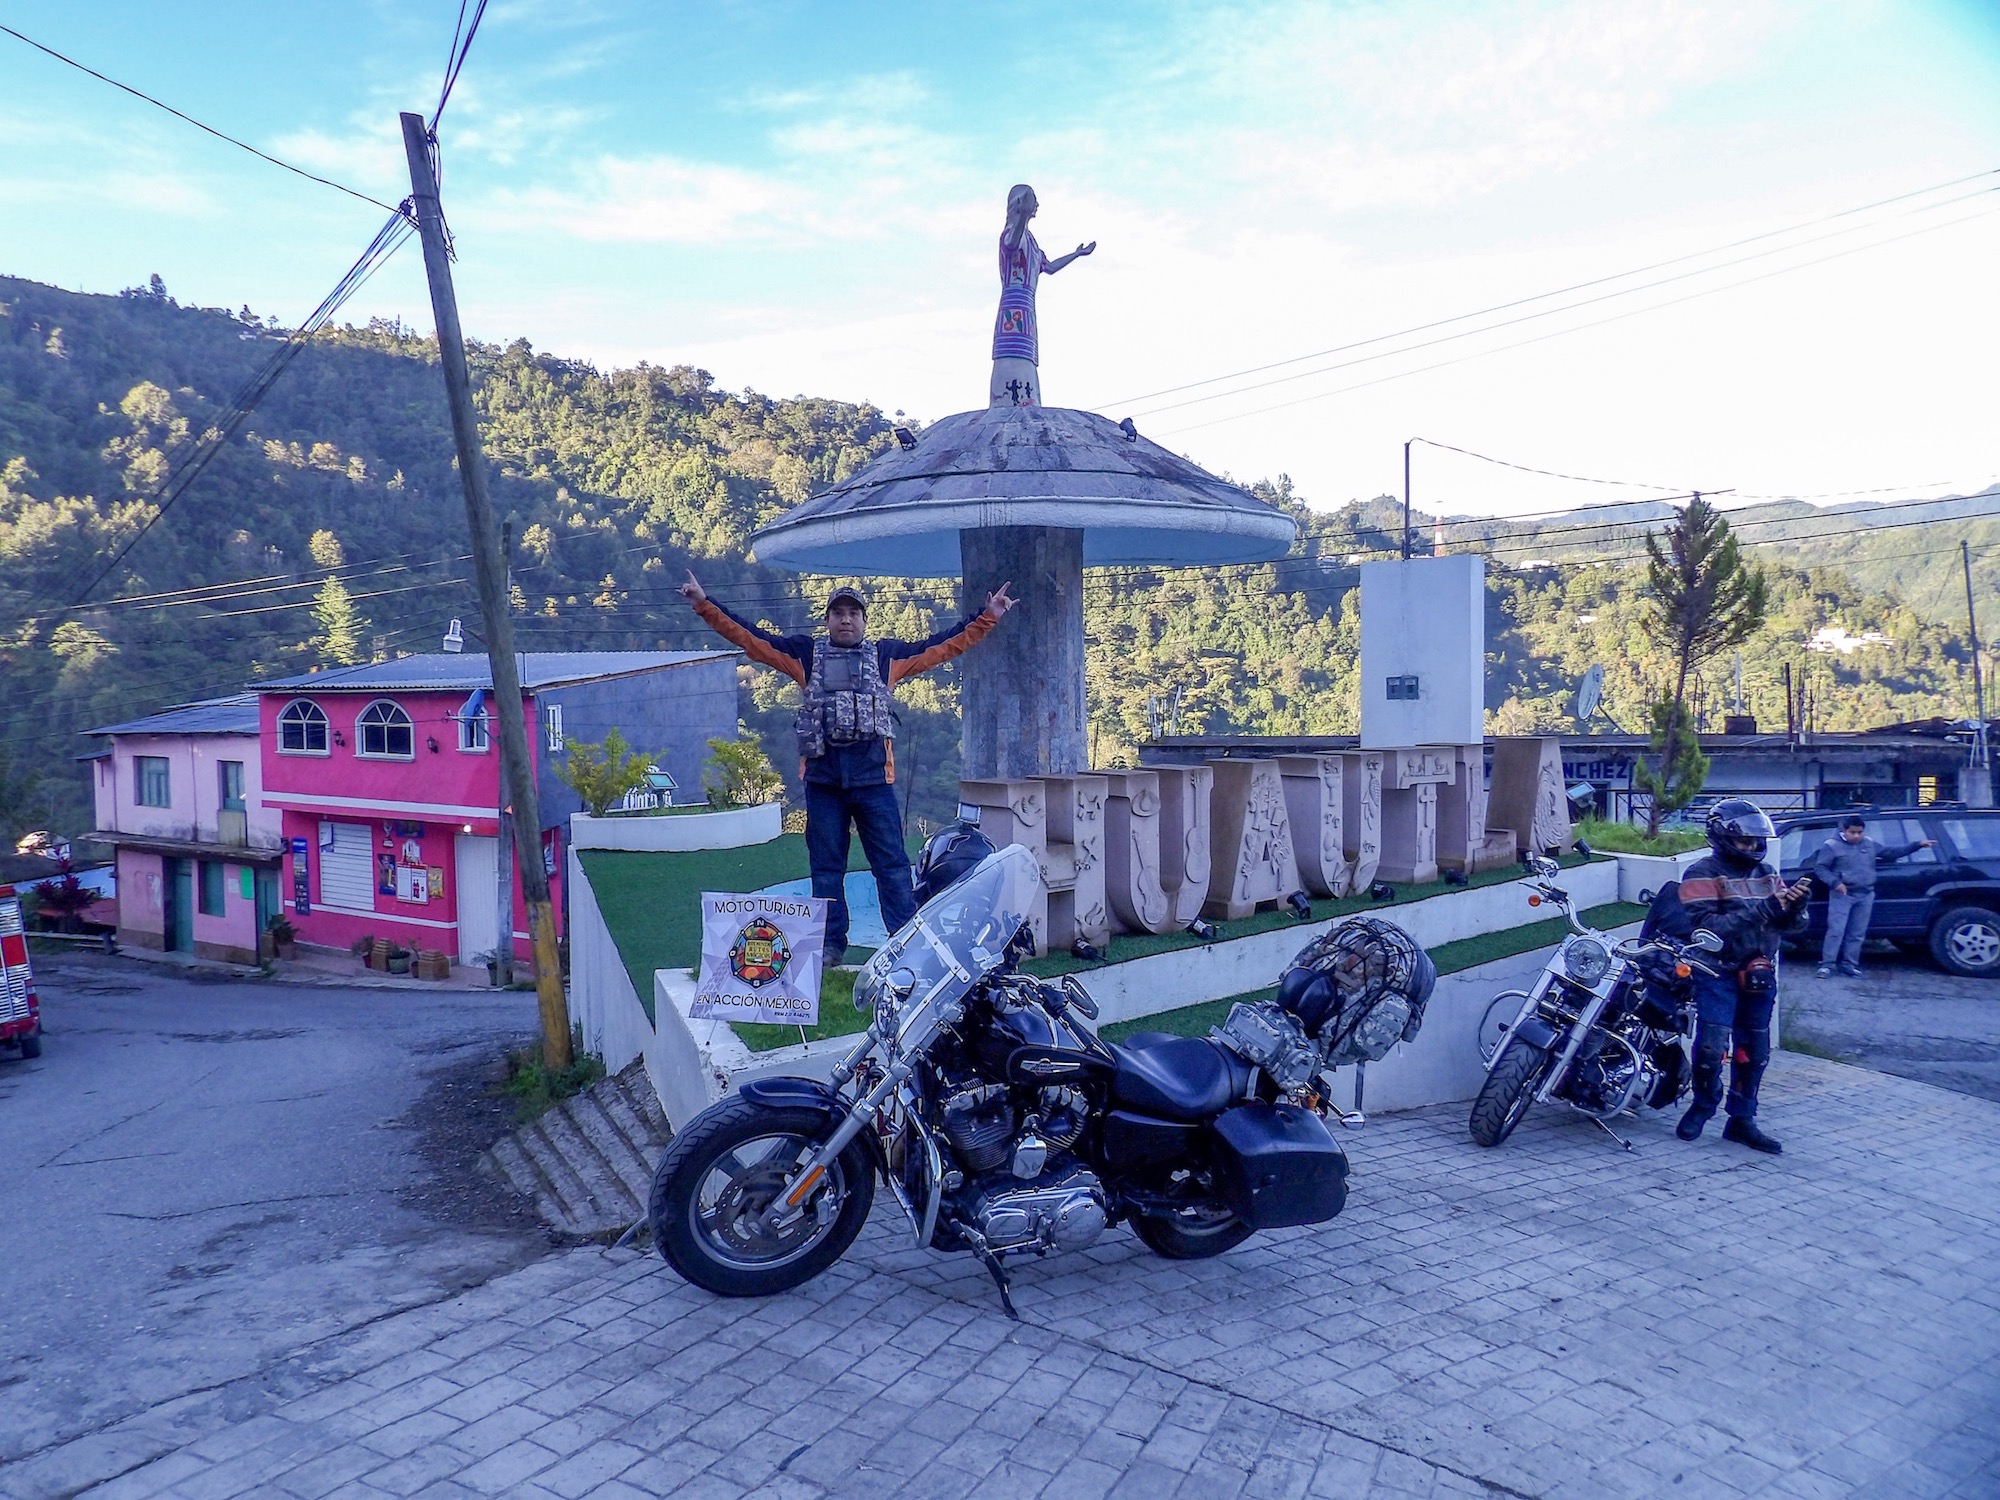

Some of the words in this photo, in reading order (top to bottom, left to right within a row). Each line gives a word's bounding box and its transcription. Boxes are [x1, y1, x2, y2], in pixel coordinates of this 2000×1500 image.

[1562, 762, 1628, 779] NCHEZ
[962, 736, 1574, 958] HUAUTLA
[714, 900, 755, 914] MOTO
[758, 899, 811, 917] TURISTA
[696, 994, 710, 1006] EN
[713, 993, 763, 1007] ACCIÓN
[765, 995, 812, 1010] MÉXICO
